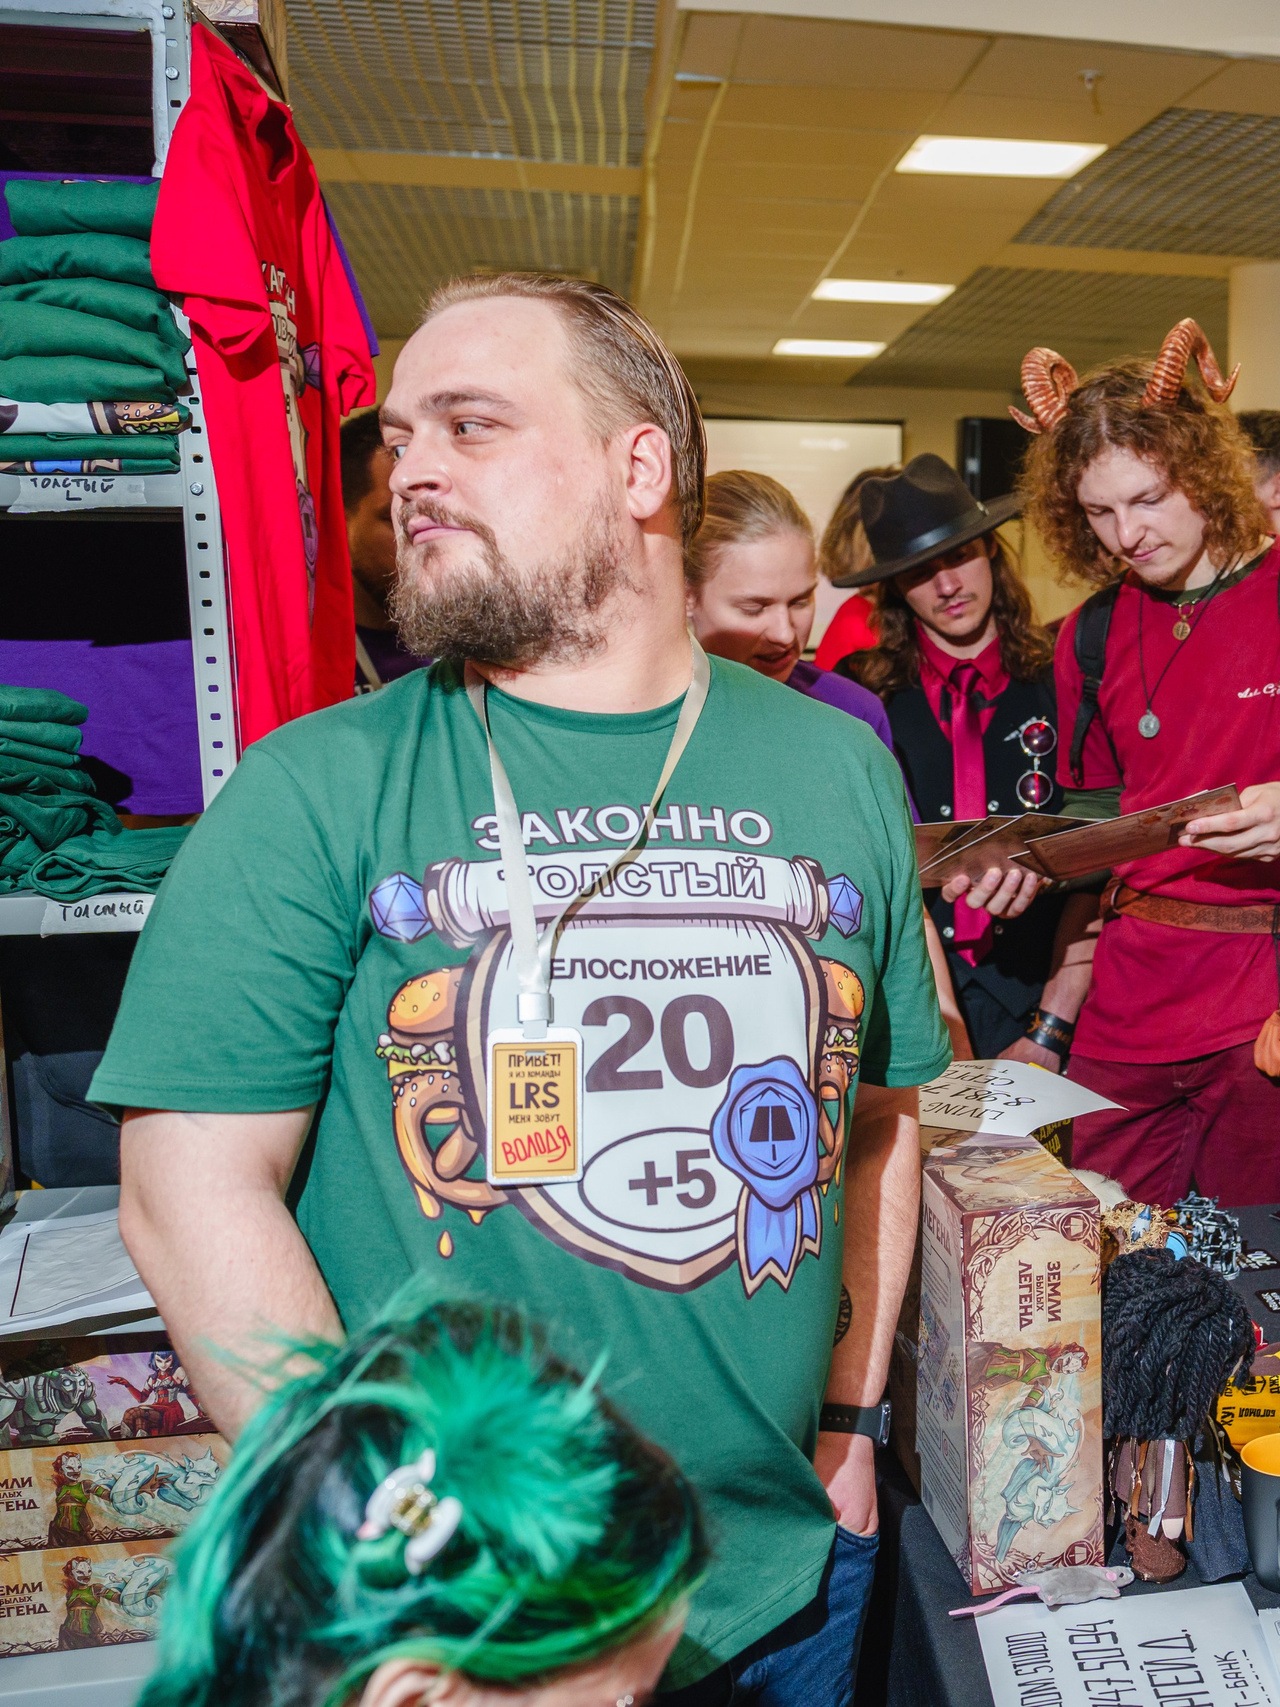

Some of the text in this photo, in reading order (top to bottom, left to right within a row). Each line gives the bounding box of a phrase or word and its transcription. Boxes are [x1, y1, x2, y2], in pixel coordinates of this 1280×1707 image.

[471, 804, 773, 850] ЗАКОННО
[497, 856, 765, 899] ОЛСТЫЙ
[550, 954, 771, 980] ЕЛОСЛОЖЕНИЕ
[581, 994, 735, 1092] 20
[508, 1053, 561, 1068] ПРИВЕТ!
[942, 1069, 1015, 1087] СЕРГЕ
[950, 1086, 1011, 1103] 981
[510, 1082, 560, 1109] LRS
[923, 1102, 1005, 1121] LIVING
[1003, 1096, 1035, 1107] 8
[509, 1114, 560, 1124] МЕНЯ ЗОВУТ
[501, 1125, 571, 1166] ВОЛОДЯ
[629, 1149, 716, 1209] +5
[1018, 1260, 1033, 1332] ЛЕГЕНД
[1035, 1275, 1044, 1312] БЫЛЫХ
[1047, 1261, 1062, 1323] ЗЕМЛИ
[1005, 1631, 1055, 1677] STUDIO
[1083, 1678, 1144, 1707] 47
